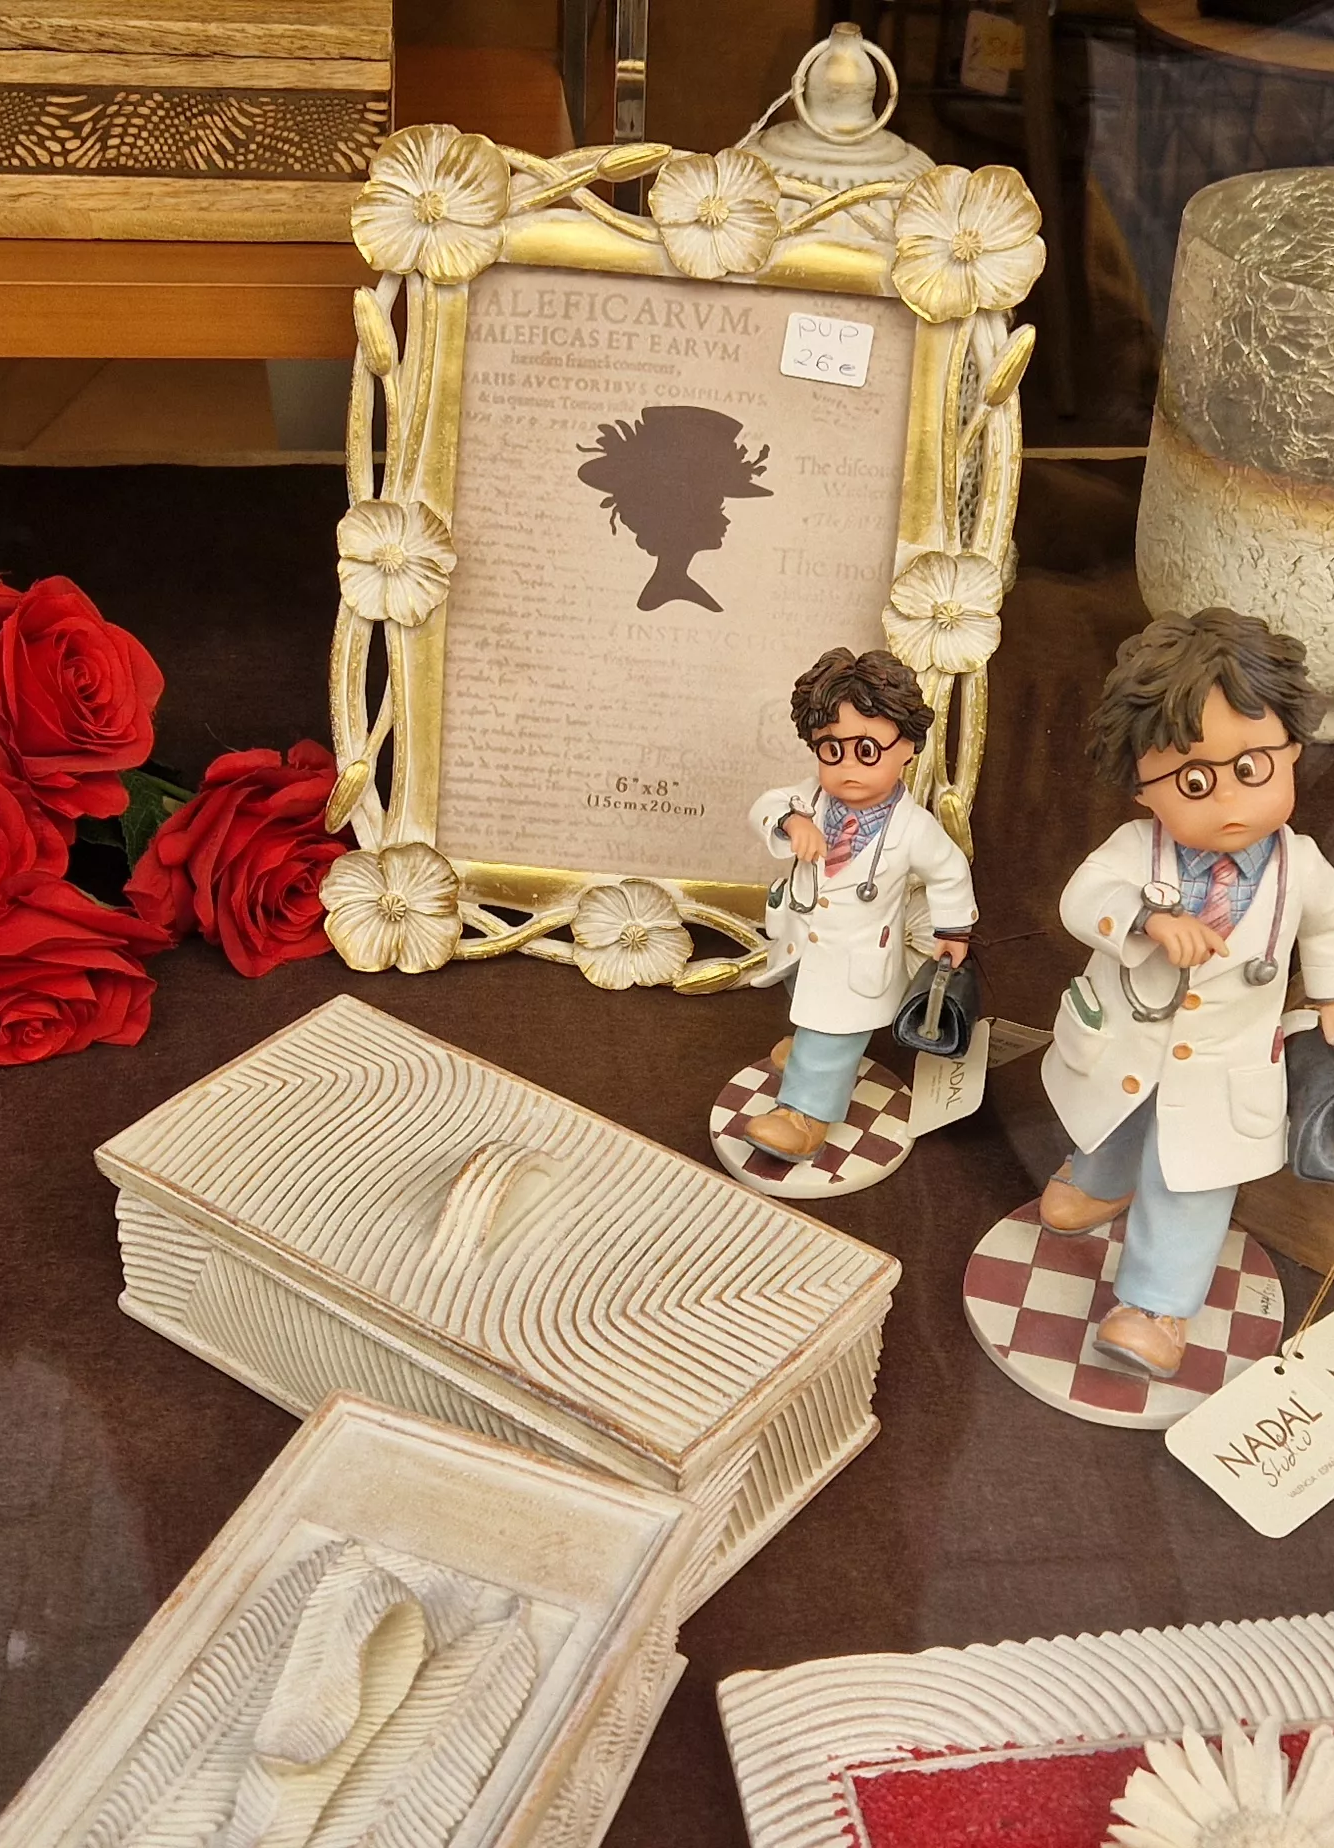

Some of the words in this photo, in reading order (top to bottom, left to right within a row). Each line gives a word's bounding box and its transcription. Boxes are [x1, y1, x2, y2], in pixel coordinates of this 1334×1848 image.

[466, 322, 601, 349] MALEFICAS
[607, 331, 640, 352] ET
[797, 316, 860, 344] PUP
[795, 454, 831, 477] The
[774, 546, 828, 577] The
[586, 793, 706, 818] (15cmx20cm)
[945, 1057, 967, 1110] ADAL
[1213, 1395, 1323, 1479] NADAL
[1261, 1429, 1312, 1488] Studio
